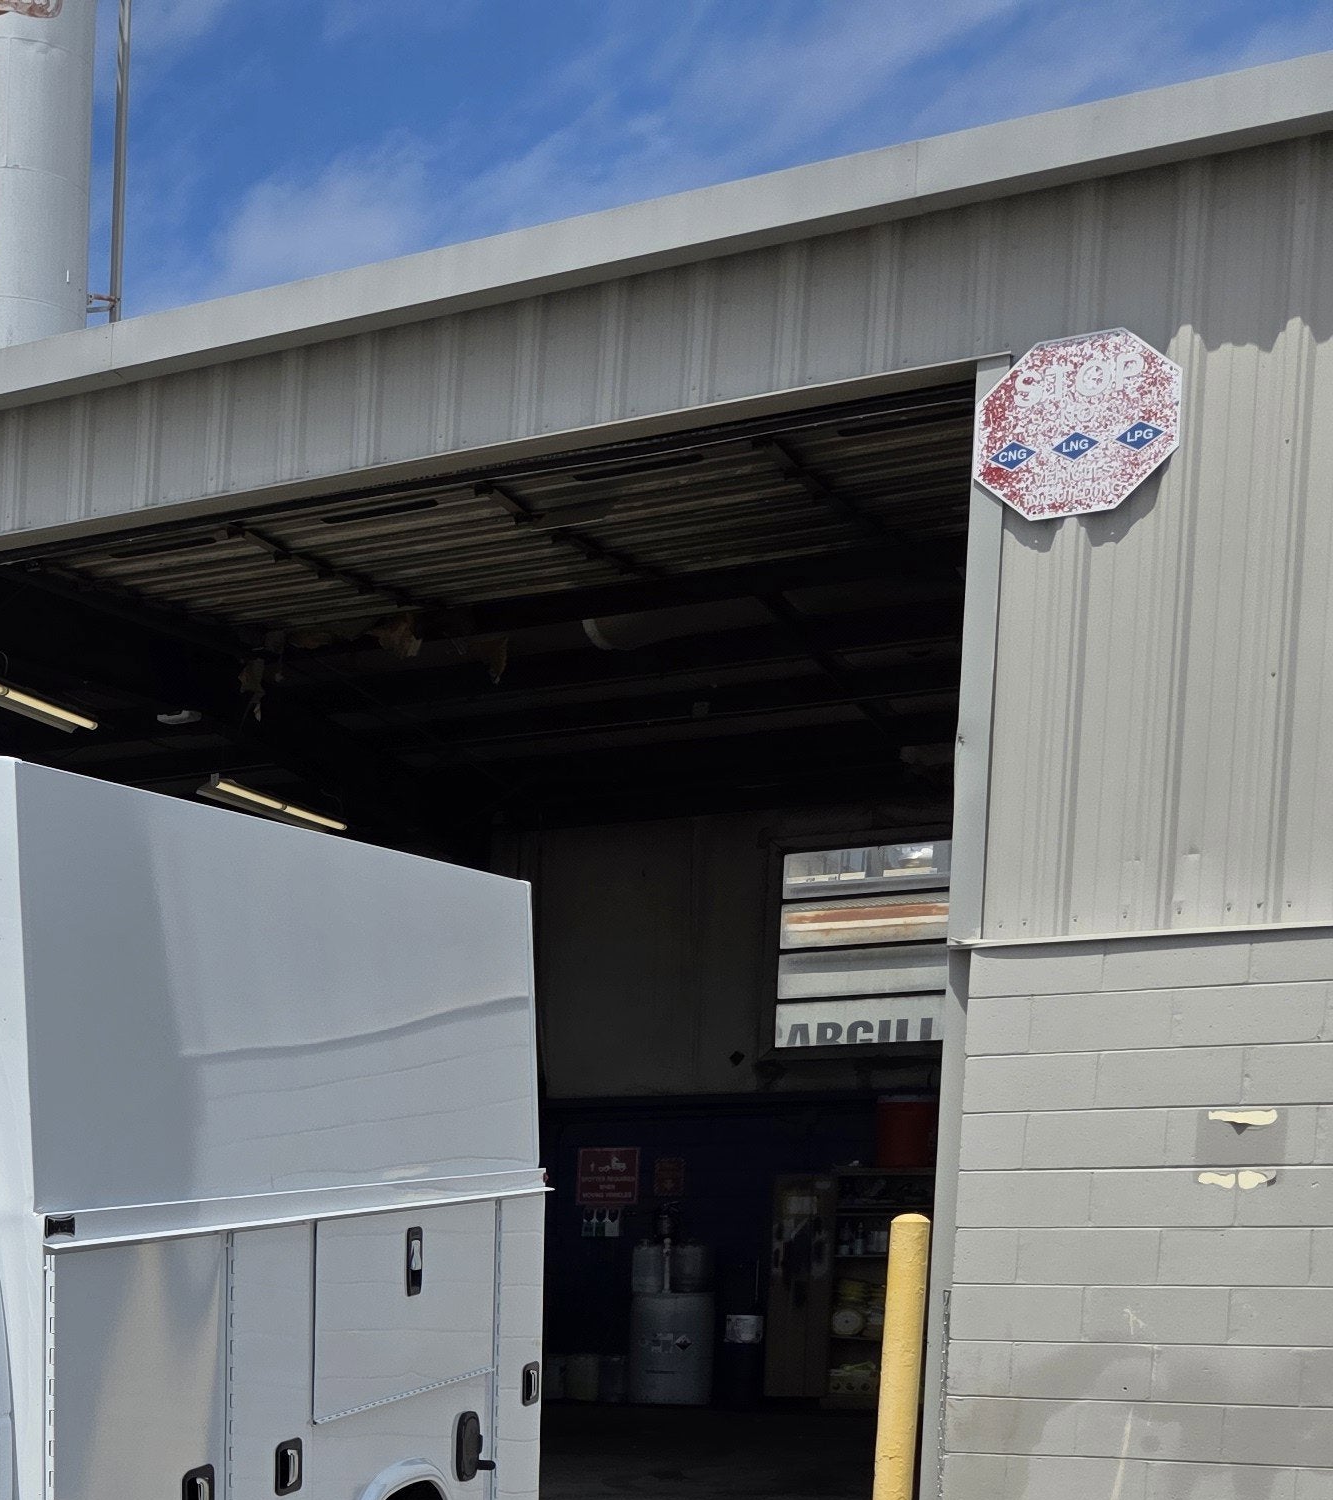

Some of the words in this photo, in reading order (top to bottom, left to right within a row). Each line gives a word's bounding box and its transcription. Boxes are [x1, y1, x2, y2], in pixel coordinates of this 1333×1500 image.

[1013, 352, 1145, 408] STOP
[998, 449, 1028, 463] CNG
[1062, 439, 1089, 453] LNG
[1126, 428, 1154, 442] LPG
[776, 1017, 934, 1047] ARGILL
